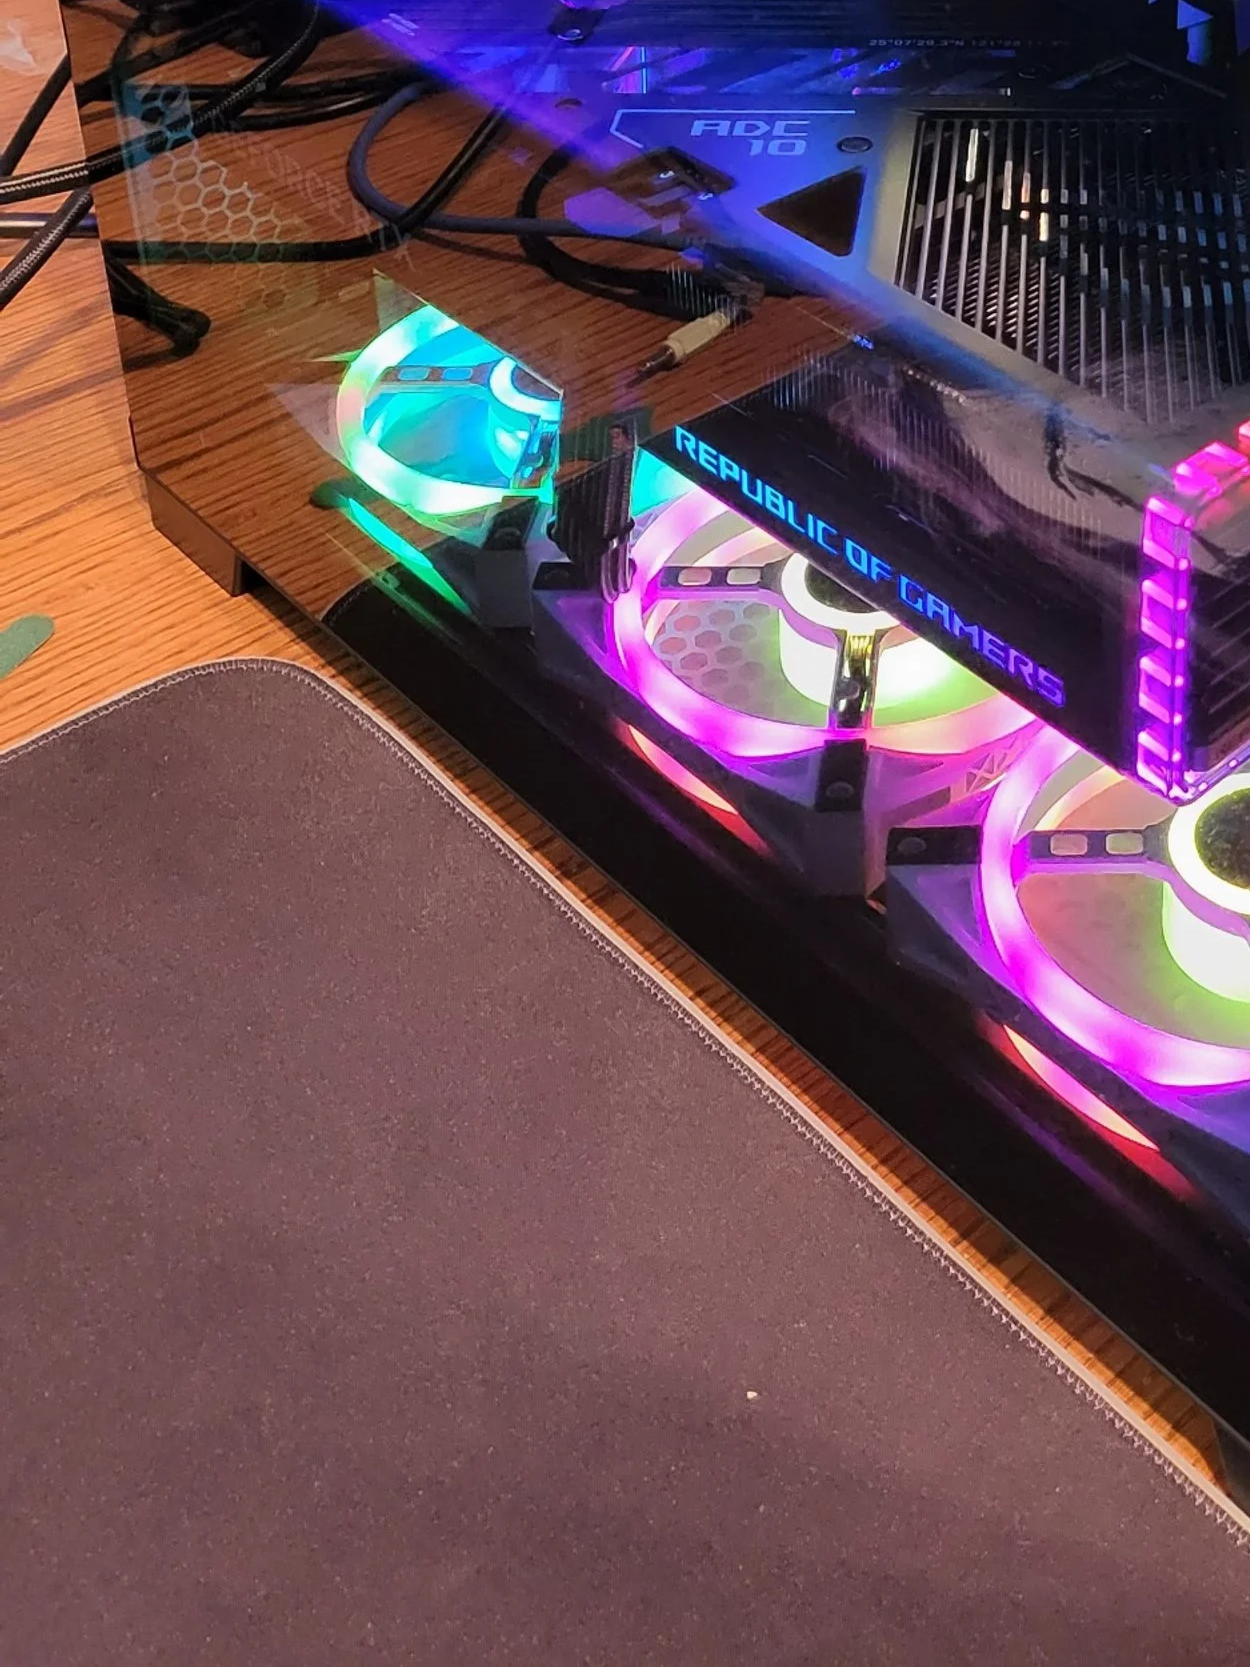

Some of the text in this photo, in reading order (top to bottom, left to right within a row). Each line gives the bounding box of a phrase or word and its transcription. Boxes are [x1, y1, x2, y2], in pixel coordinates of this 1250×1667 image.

[690, 120, 811, 137] ADC
[747, 139, 807, 156] 10
[674, 424, 1067, 708] REPUBLIC OF GAMERS
